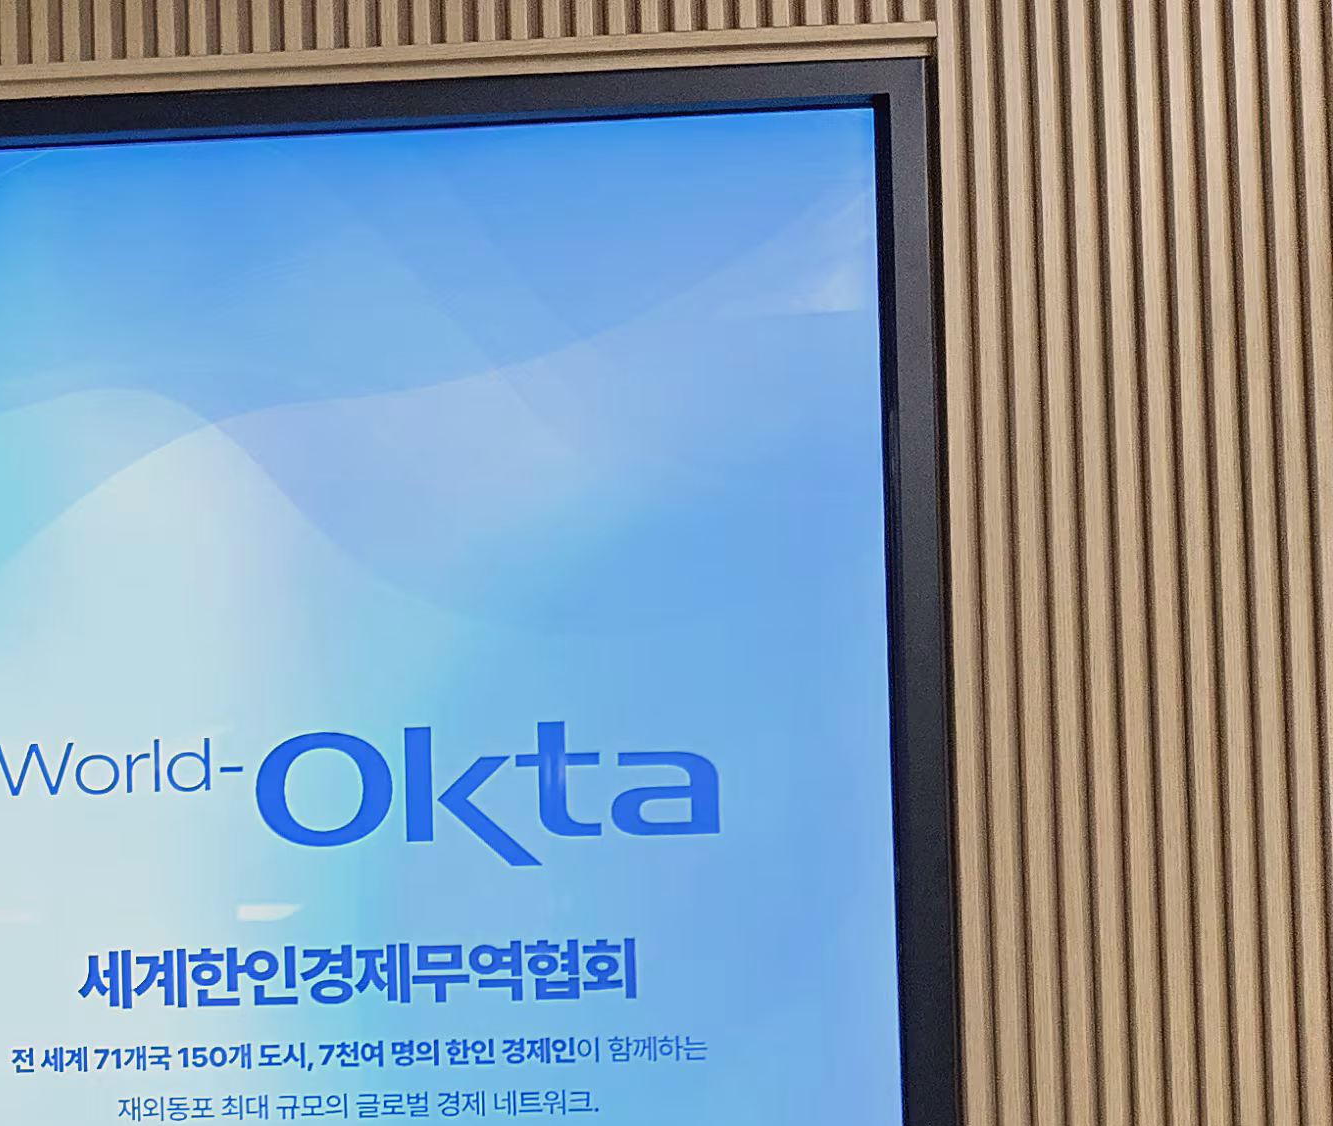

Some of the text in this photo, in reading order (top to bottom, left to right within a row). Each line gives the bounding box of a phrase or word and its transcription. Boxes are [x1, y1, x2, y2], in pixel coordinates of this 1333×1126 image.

[78, 937, 637, 1010] 세계한인경제무역협회
[11, 1035, 708, 1073] 전 세계 71개국 150개 도시, 7천여 명의 한인 경제인이 함께하는
[118, 1089, 600, 1122] 재외동포 최대 규모의 글로벌 경제 네트워크.
